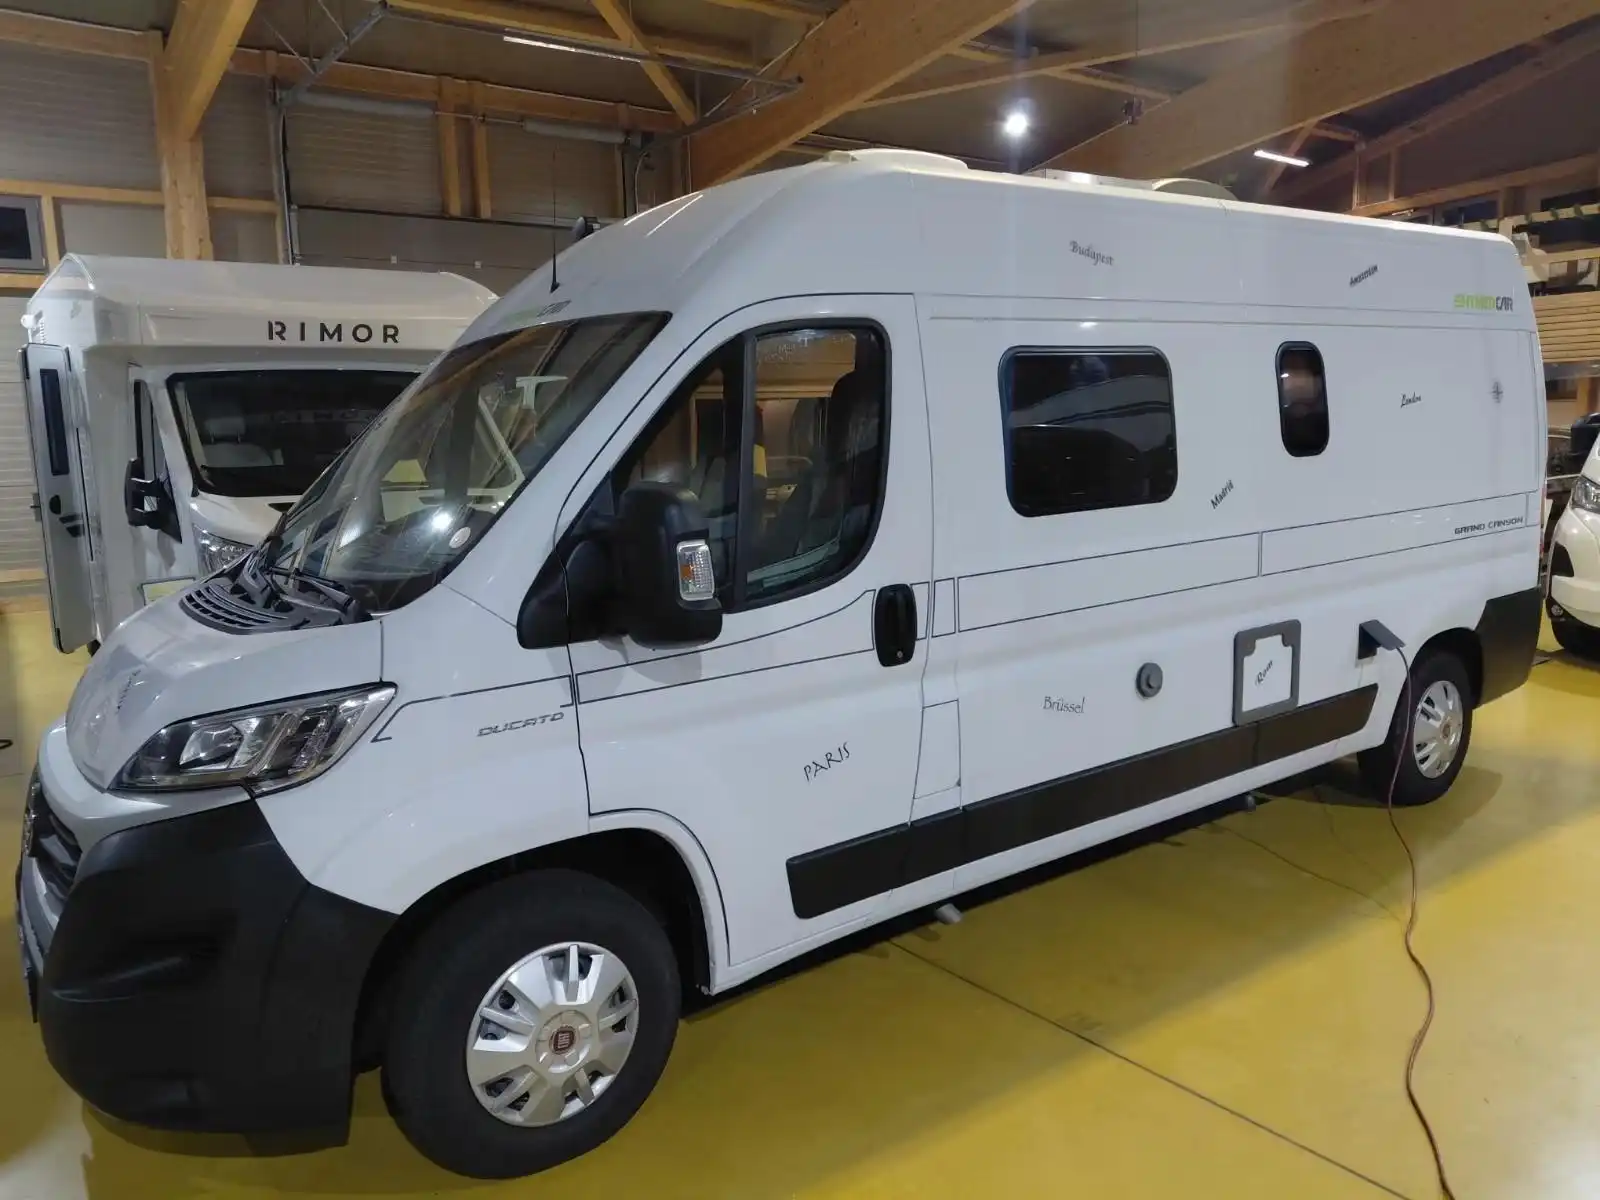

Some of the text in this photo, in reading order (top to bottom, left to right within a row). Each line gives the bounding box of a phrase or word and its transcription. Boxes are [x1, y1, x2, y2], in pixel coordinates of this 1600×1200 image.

[1069, 240, 1114, 266] Budapest
[268, 320, 399, 343] RIMOR
[1210, 479, 1233, 509] Madrid
[1454, 517, 1523, 534] GRAND CANYON
[1043, 696, 1085, 714] Brüssel
[477, 712, 564, 737] DUCATO
[803, 741, 850, 781] PARIS
